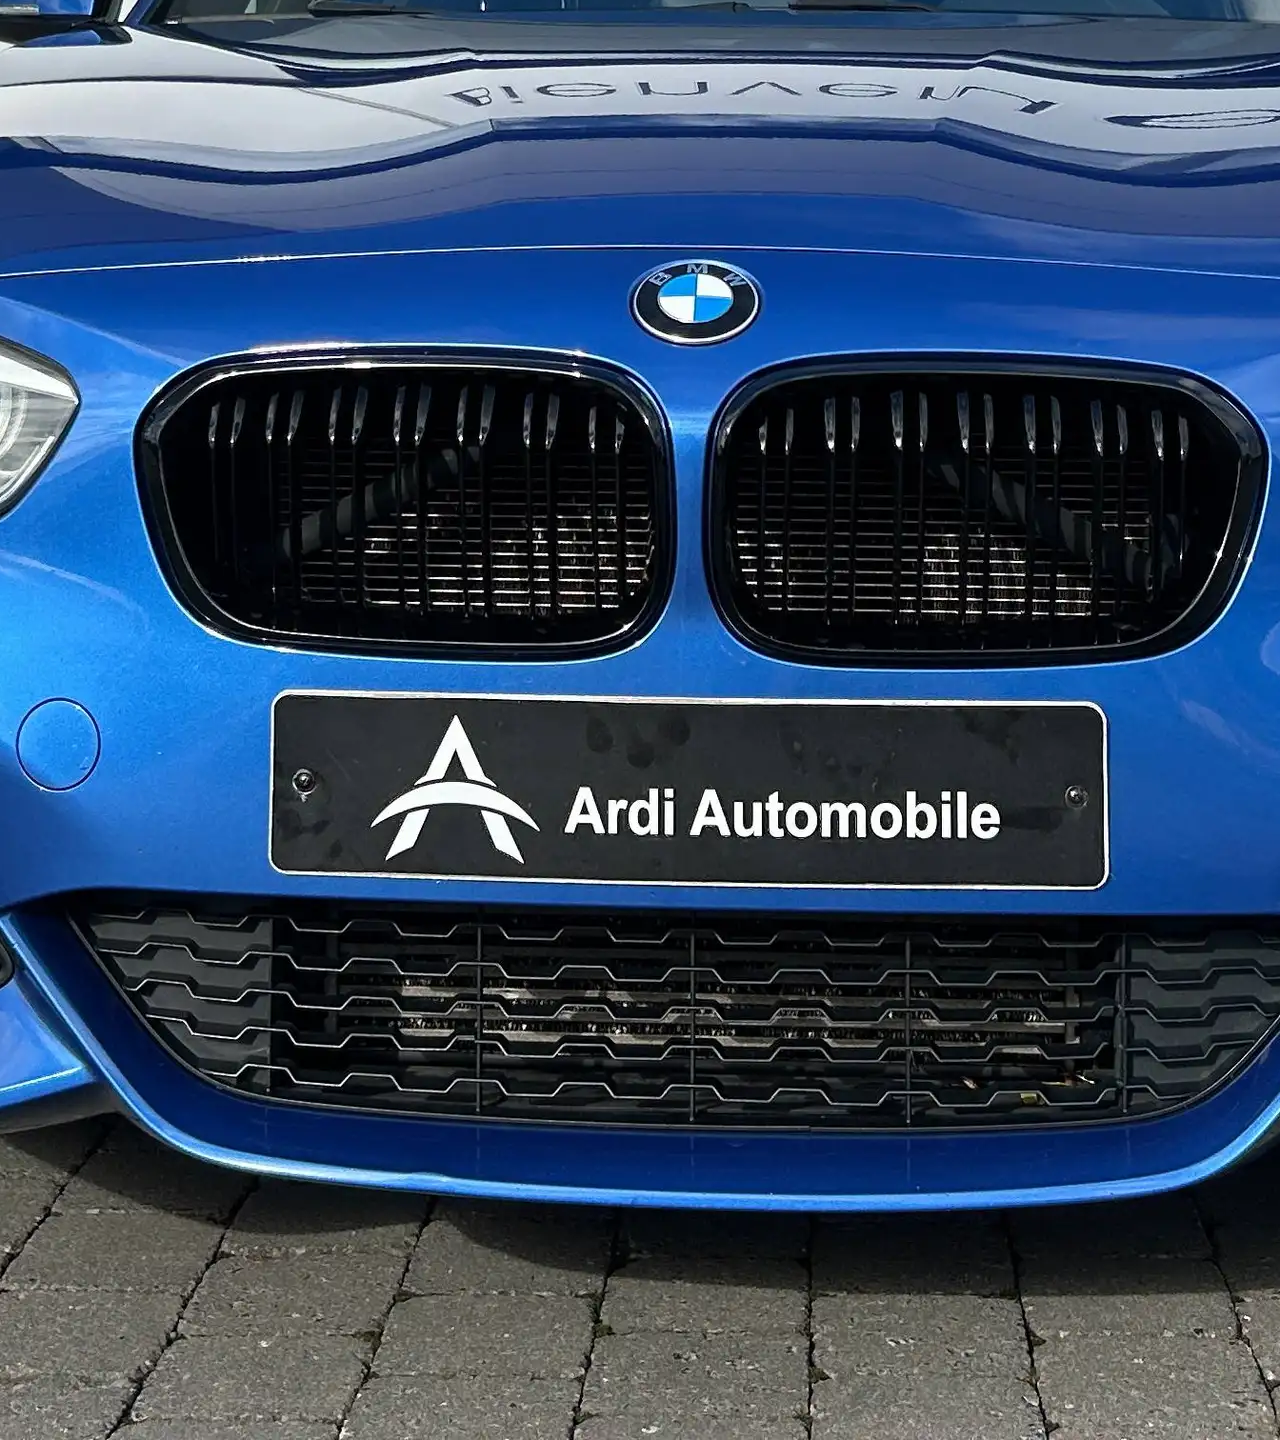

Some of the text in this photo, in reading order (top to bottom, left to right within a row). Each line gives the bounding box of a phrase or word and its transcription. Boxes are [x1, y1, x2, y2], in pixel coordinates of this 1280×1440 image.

[649, 263, 748, 287] BMW
[564, 786, 674, 837] Ardi
[690, 788, 1001, 840] Automobile
